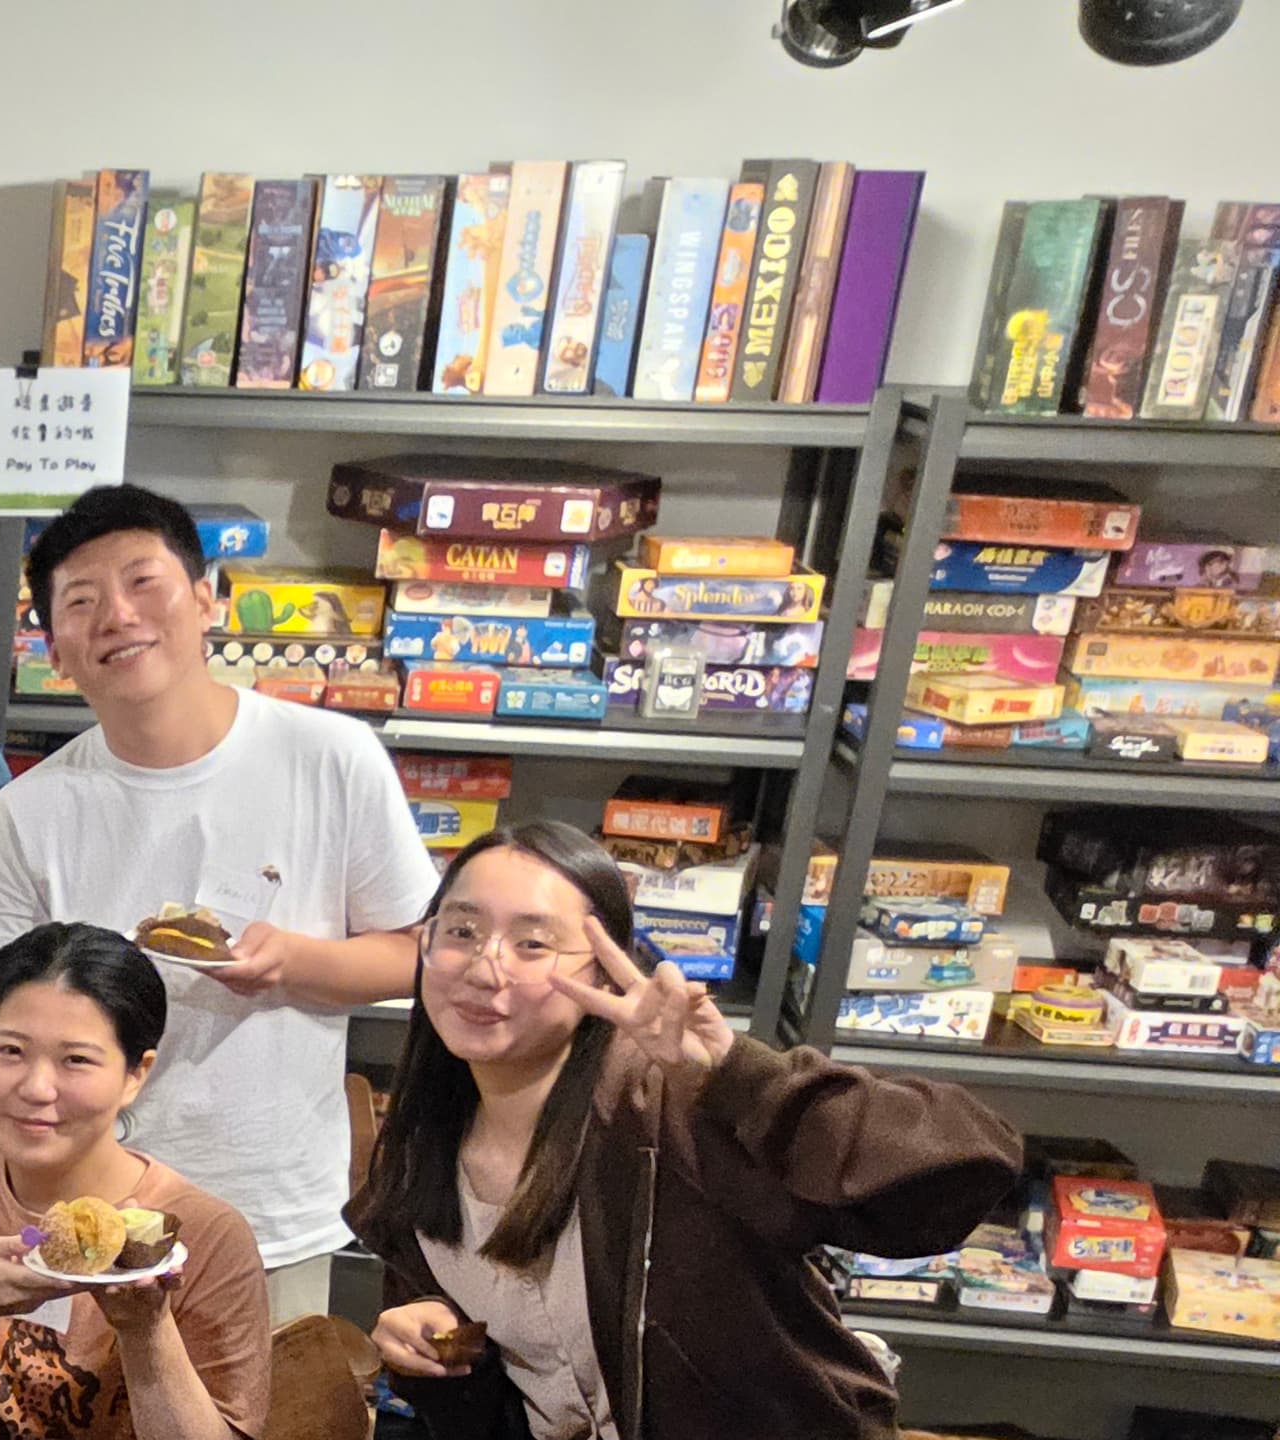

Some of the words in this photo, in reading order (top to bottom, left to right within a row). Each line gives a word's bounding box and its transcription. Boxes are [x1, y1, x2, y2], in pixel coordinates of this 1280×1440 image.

[662, 230, 704, 351] WINGSPAN
[1105, 266, 1152, 328] CS
[1164, 299, 1207, 402] ROOT
[39, 458, 59, 471] To
[65, 458, 96, 473] Play
[445, 543, 520, 571] CATAN
[673, 581, 762, 610] Splendor
[700, 669, 766, 697] ORLD
